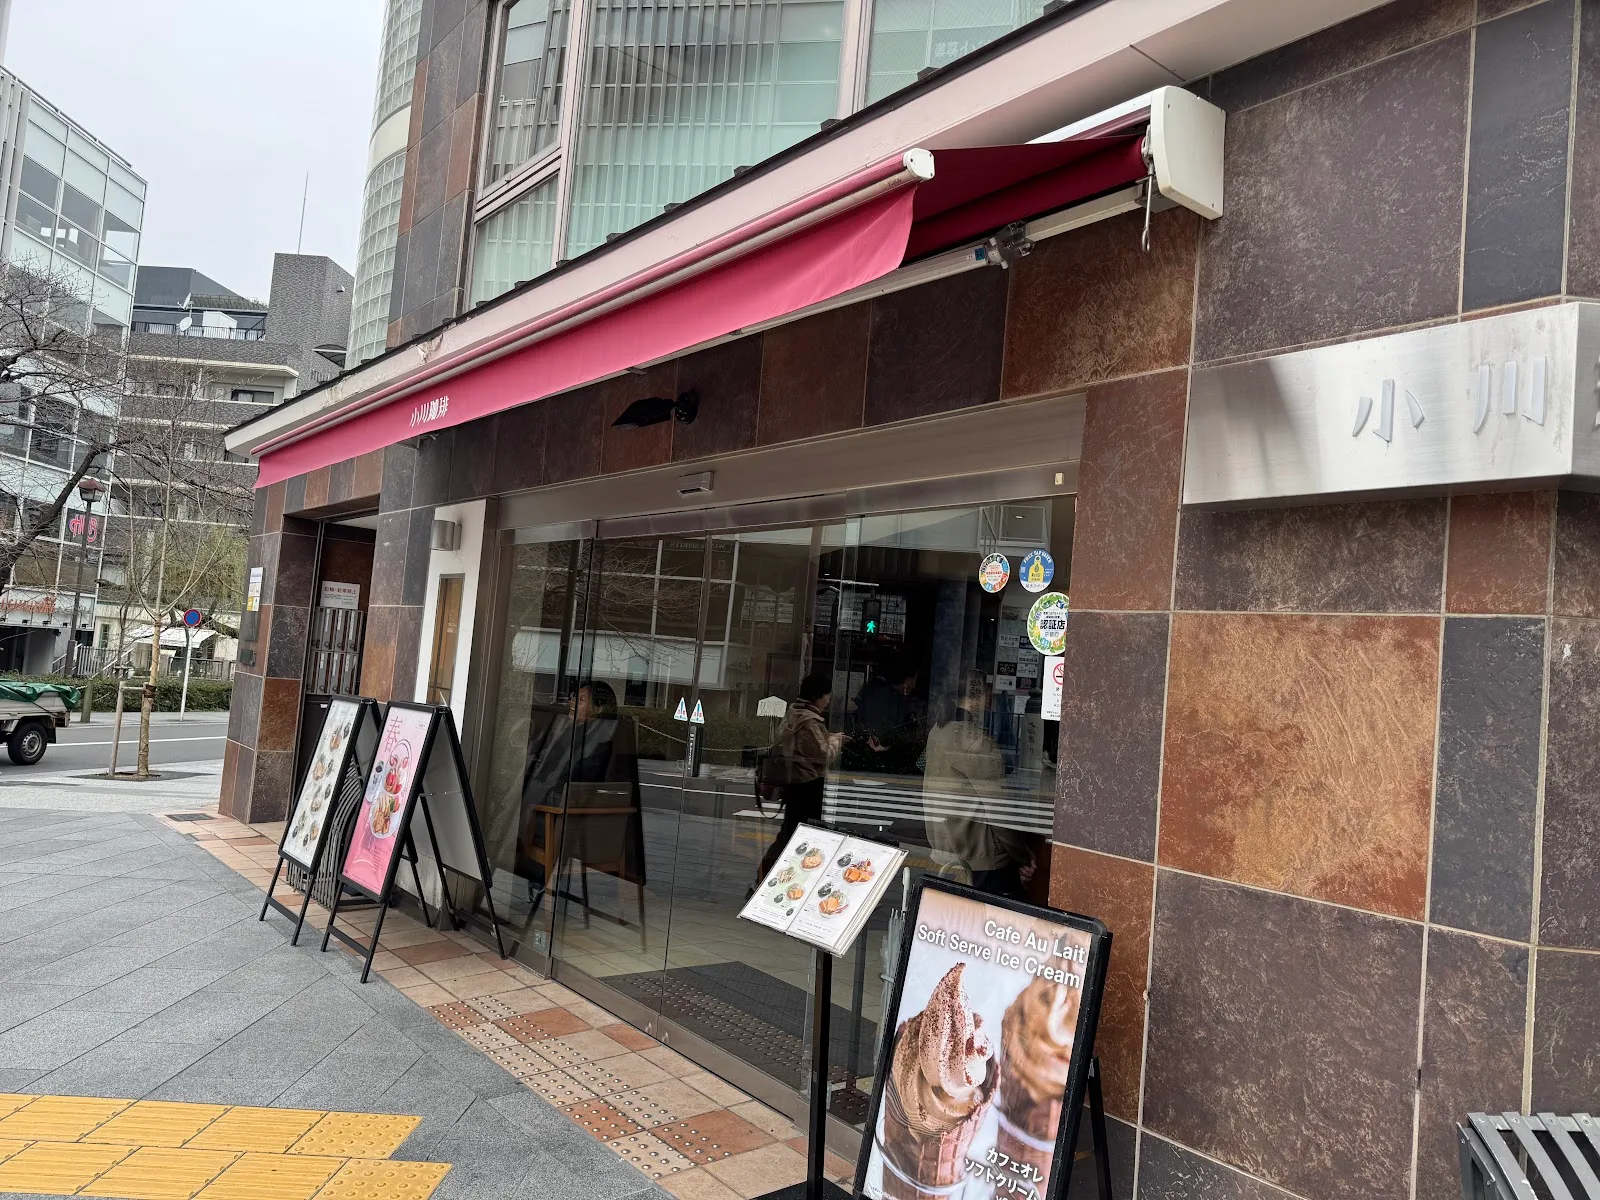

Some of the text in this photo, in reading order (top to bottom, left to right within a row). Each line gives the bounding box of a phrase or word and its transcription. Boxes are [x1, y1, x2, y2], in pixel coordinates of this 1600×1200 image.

[1040, 619, 1066, 630] 認証店
[384, 716, 404, 753] 春
[917, 924, 1080, 989] Soft Serve Ice Cream
[984, 920, 1086, 963] Cafe Au Lait
[985, 1148, 1044, 1183] カフェオレ
